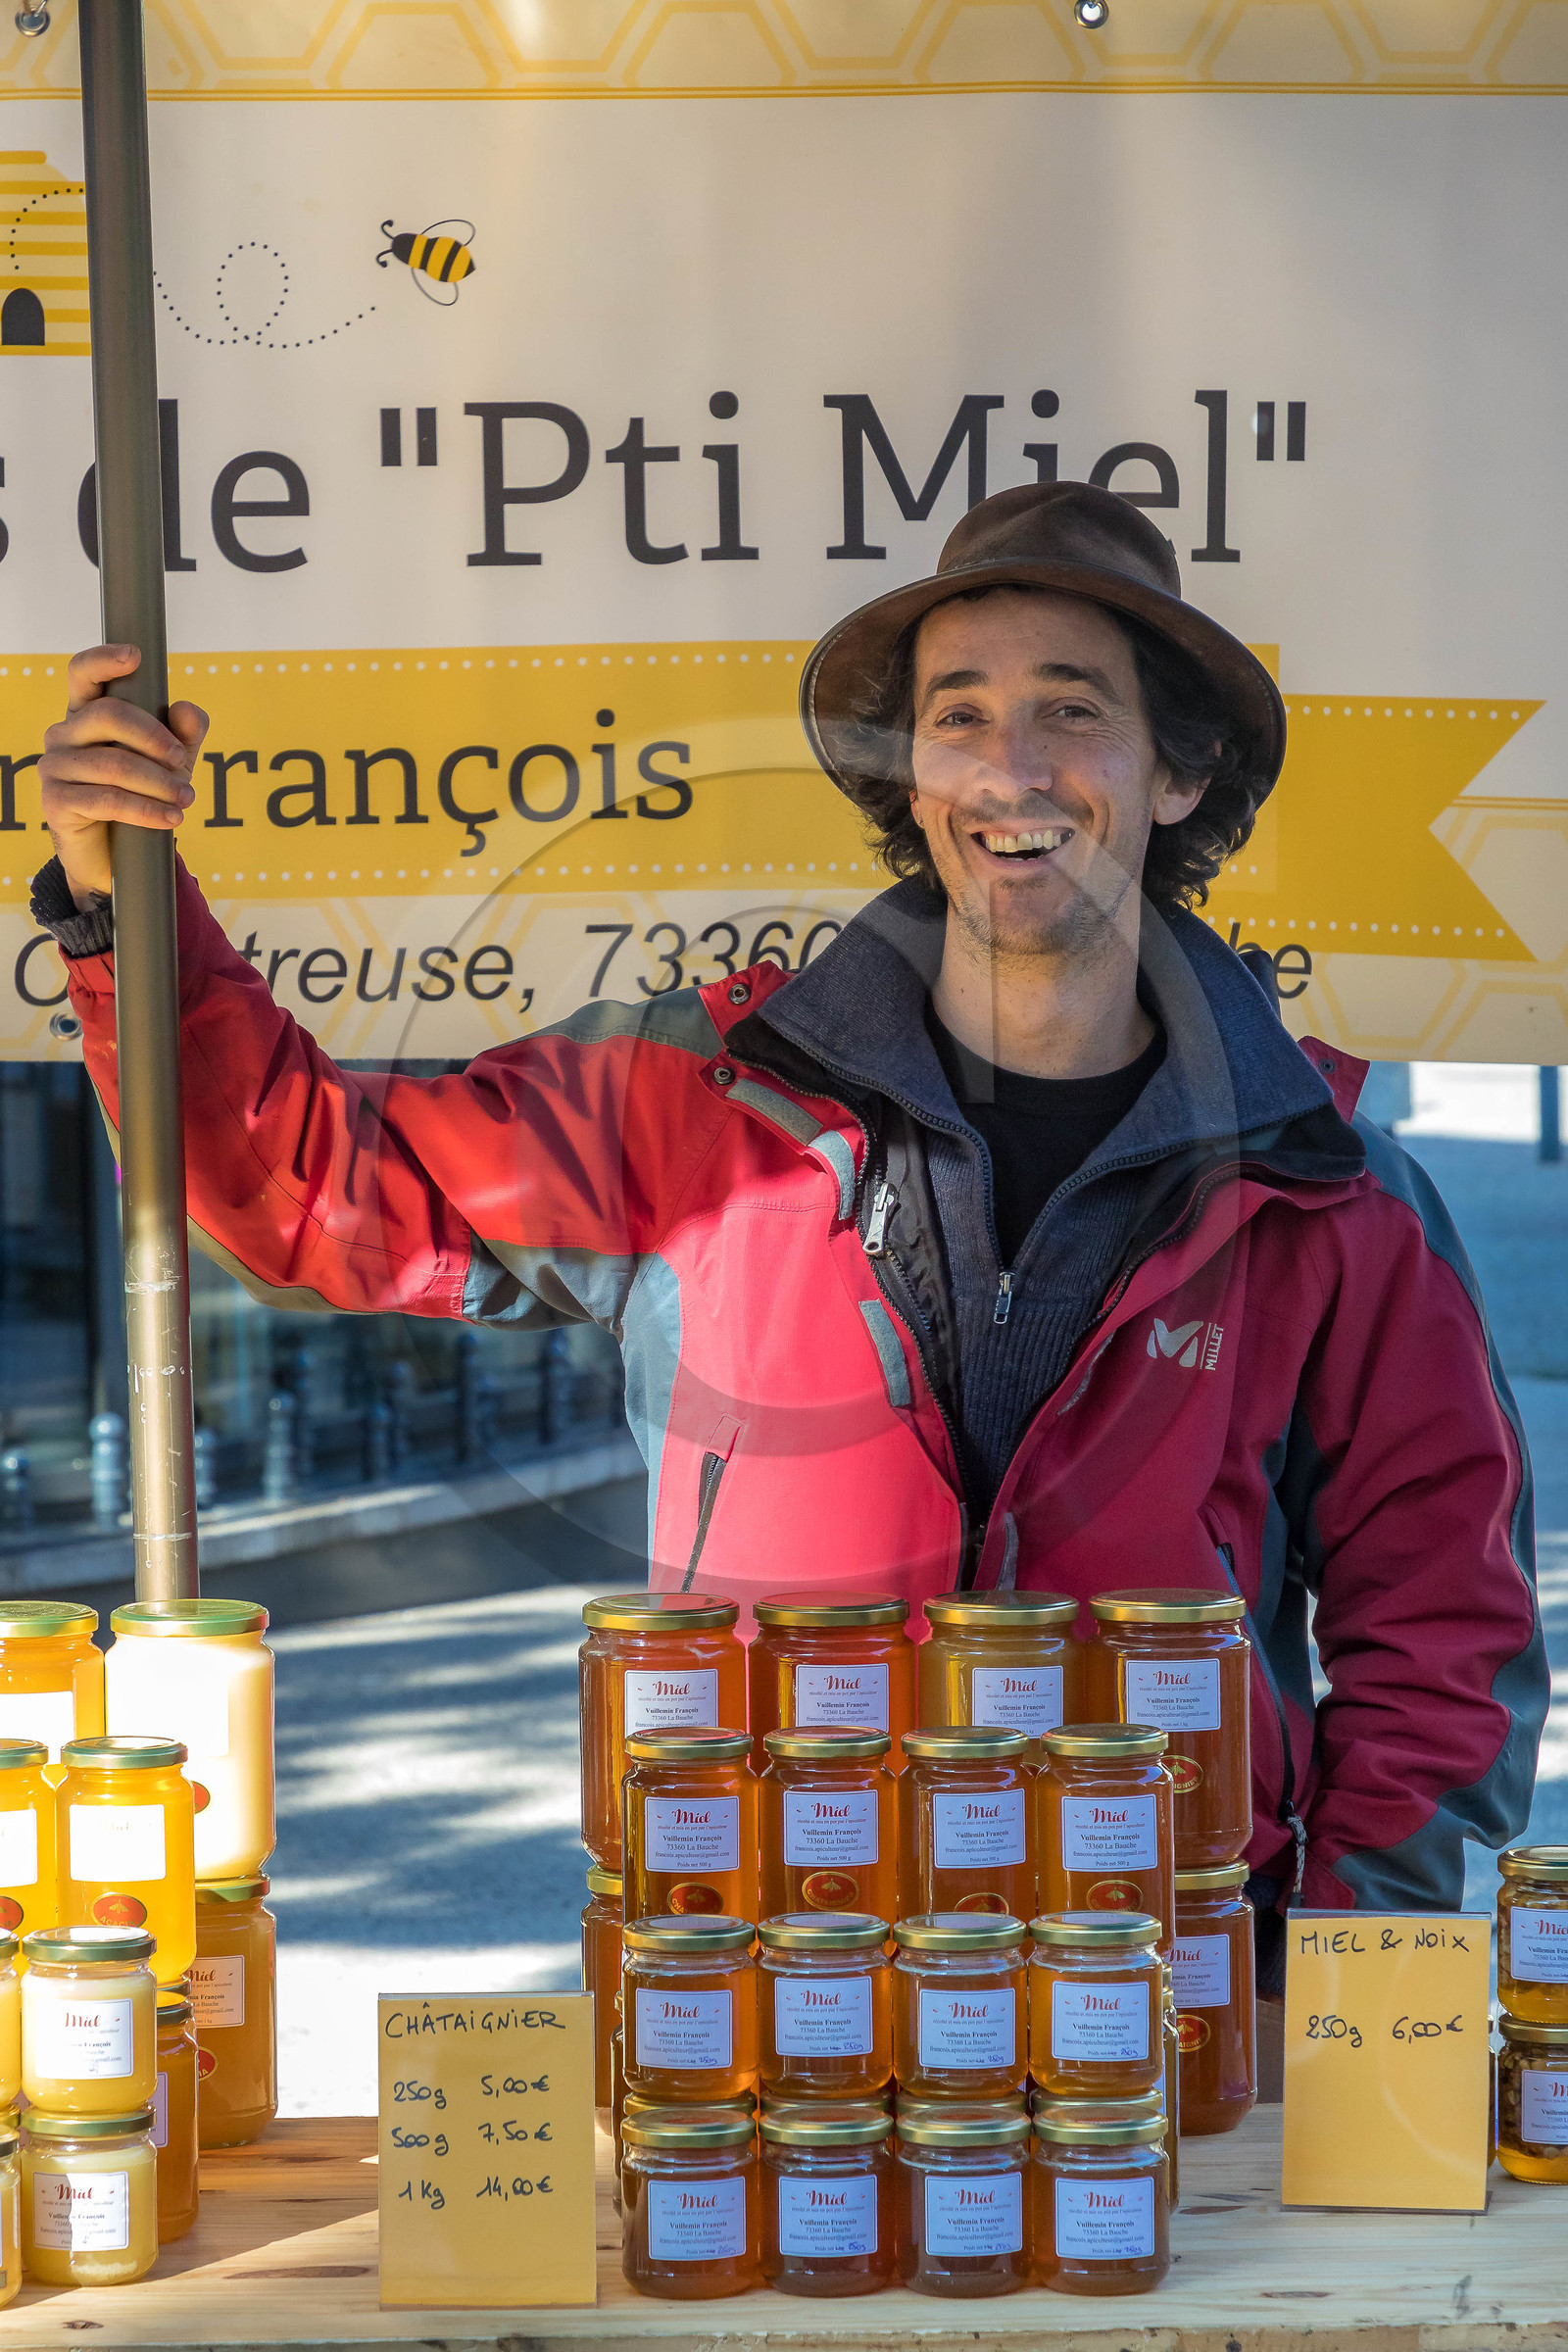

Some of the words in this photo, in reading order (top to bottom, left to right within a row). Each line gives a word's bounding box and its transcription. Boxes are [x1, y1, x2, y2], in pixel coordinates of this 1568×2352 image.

[379, 390, 760, 566] "Pti
[203, 709, 693, 858] rançois
[1204, 1323, 1224, 1371] MILLET
[823, 1675, 861, 1690] Miel
[1001, 1678, 1038, 1692] Miel
[1152, 1670, 1192, 1686] Miel
[653, 1681, 690, 1696] Miel
[671, 1808, 711, 1824] Miel
[810, 1802, 851, 1818] Miel
[961, 1803, 1001, 1819] Miel
[1089, 1807, 1129, 1823] Miel
[834, 1828, 861, 1837] François
[1113, 1833, 1140, 1841] François
[1301, 1930, 1366, 1955] MIEL
[1380, 1929, 1402, 1948] &
[800, 1989, 841, 2006] Miel
[1080, 1994, 1121, 2011] Miel
[659, 2001, 701, 2018] Miel
[948, 2002, 988, 2019] Miel
[65, 2012, 101, 2028] Miel
[653, 2030, 682, 2038] Vuillemin
[1305, 2015, 1363, 2048] 250g
[393, 2081, 447, 2109] 250g
[54, 2183, 93, 2201] Miel
[806, 2189, 848, 2206] Miel
[955, 2188, 996, 2205] Miel
[1083, 2191, 1125, 2209] Miel
[676, 2192, 718, 2210] Miel
